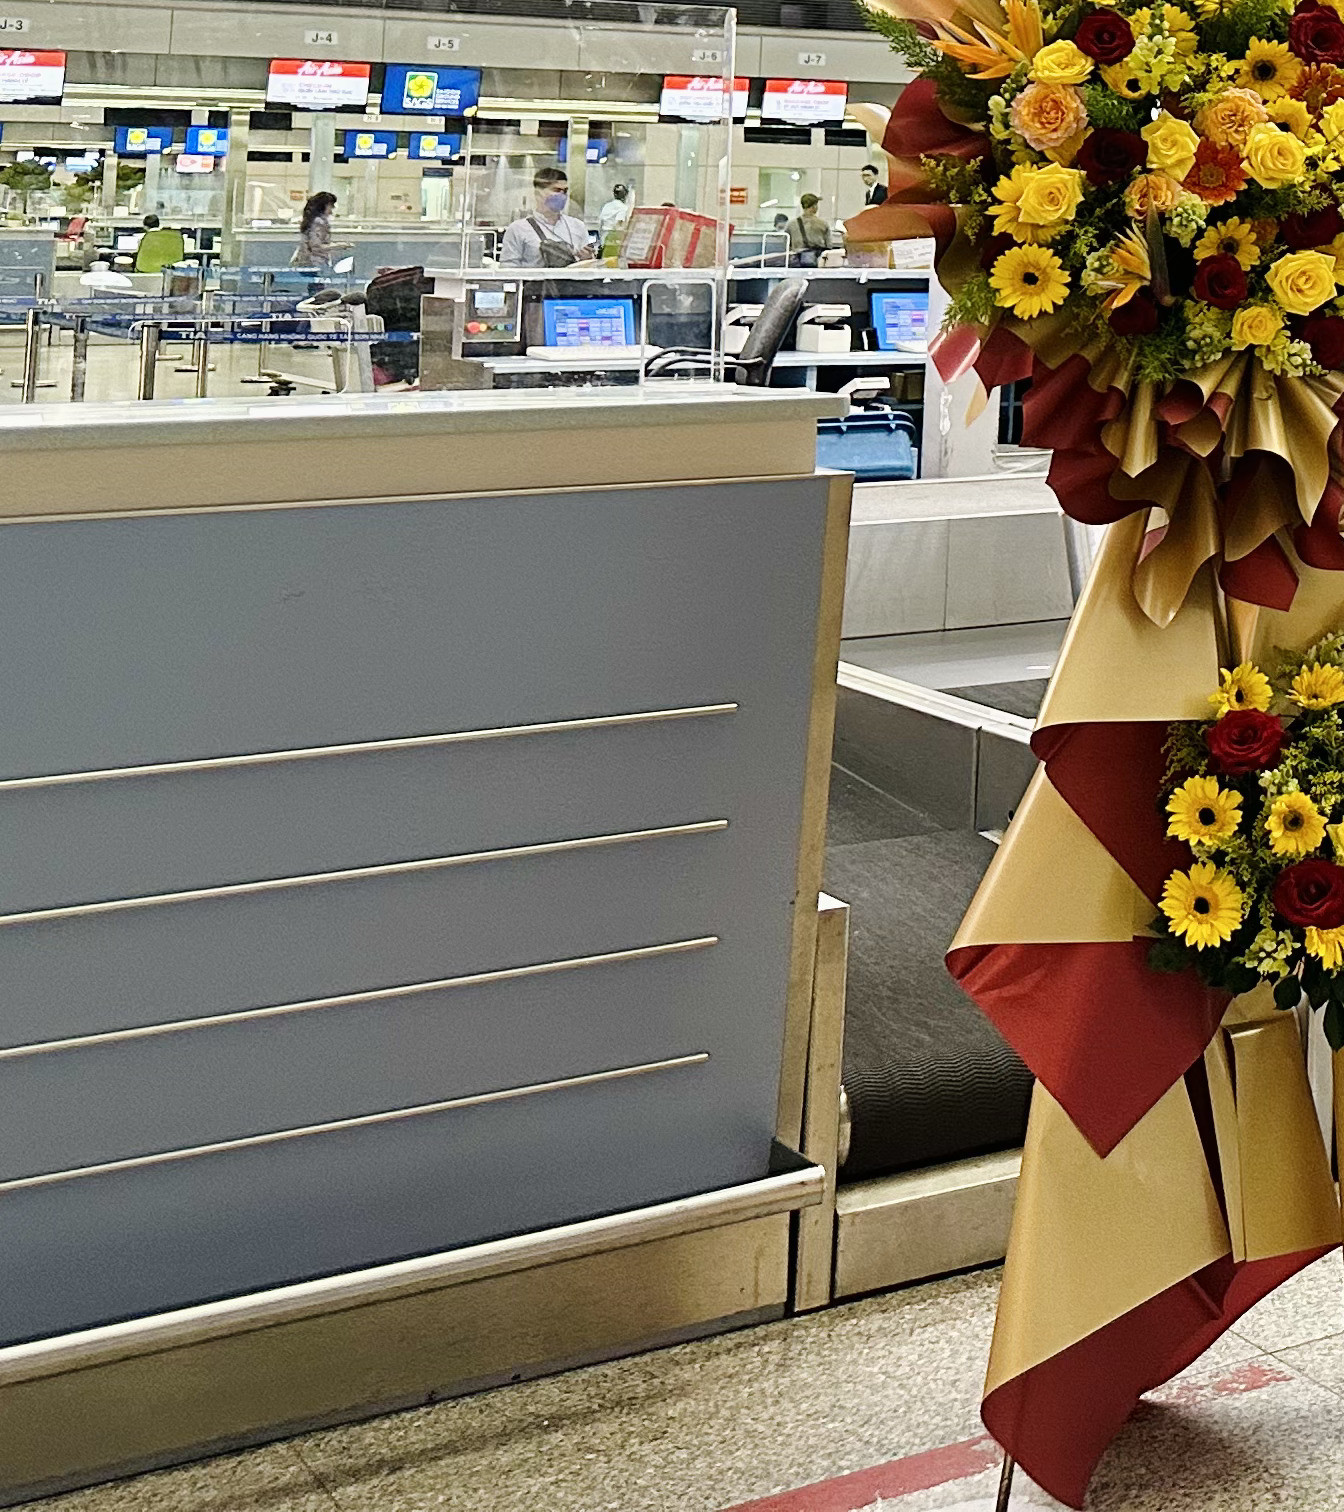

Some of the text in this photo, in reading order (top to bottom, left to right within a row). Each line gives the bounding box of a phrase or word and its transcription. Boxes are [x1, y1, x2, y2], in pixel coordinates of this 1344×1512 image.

[0, 19, 23, 30] J-3
[312, 33, 332, 43] J-4
[434, 39, 454, 49] J-5
[700, 52, 717, 61] J-6
[804, 55, 822, 64] J-7
[178, 331, 206, 340] TIA
